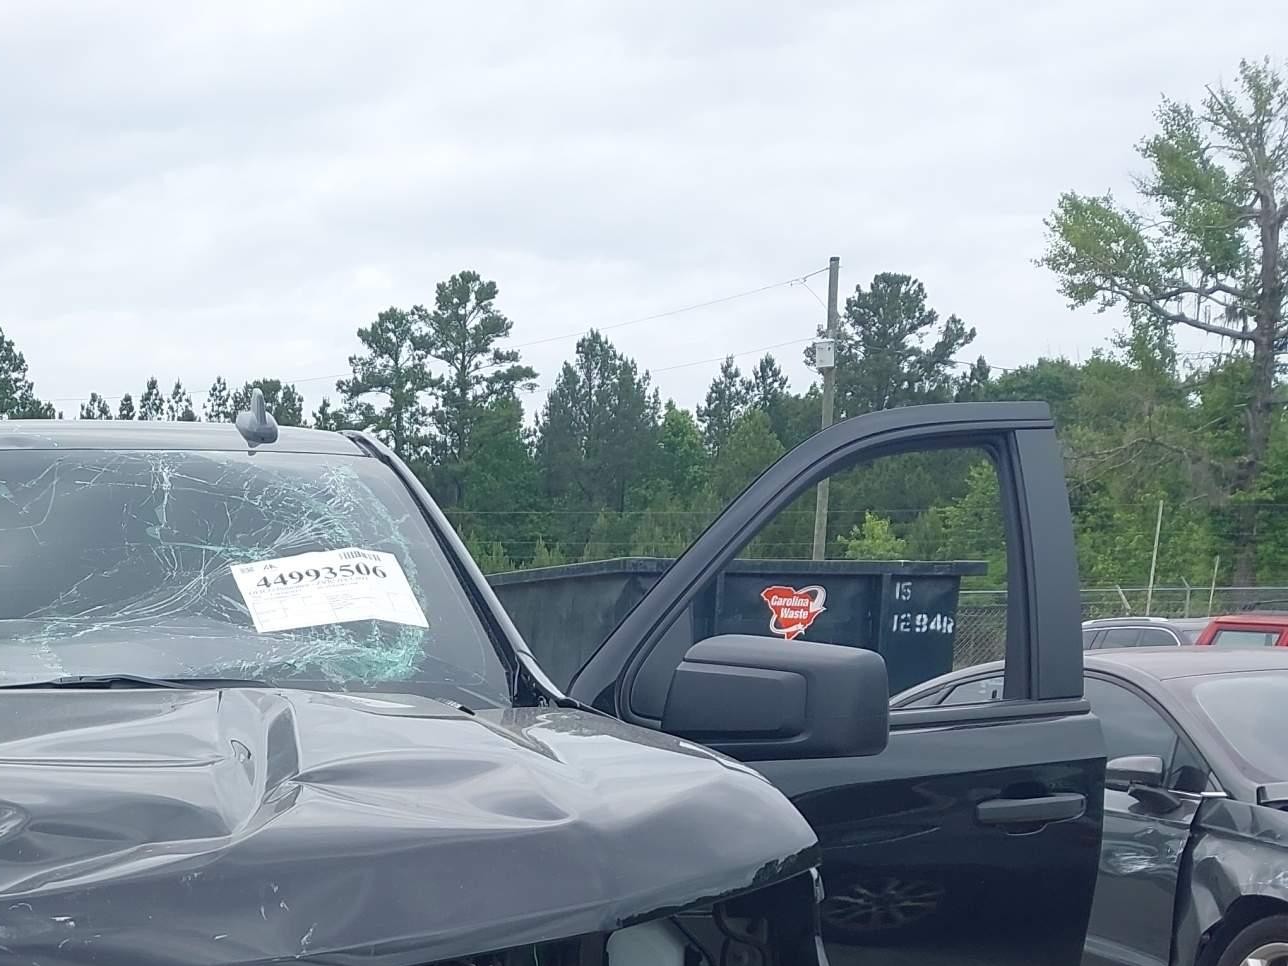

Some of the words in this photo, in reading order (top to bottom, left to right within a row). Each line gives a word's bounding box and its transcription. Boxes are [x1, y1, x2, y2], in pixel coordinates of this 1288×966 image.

[256, 562, 388, 589] 44993506
[895, 581, 913, 601] 15
[771, 595, 809, 607] Carolina
[780, 608, 809, 619] Waste
